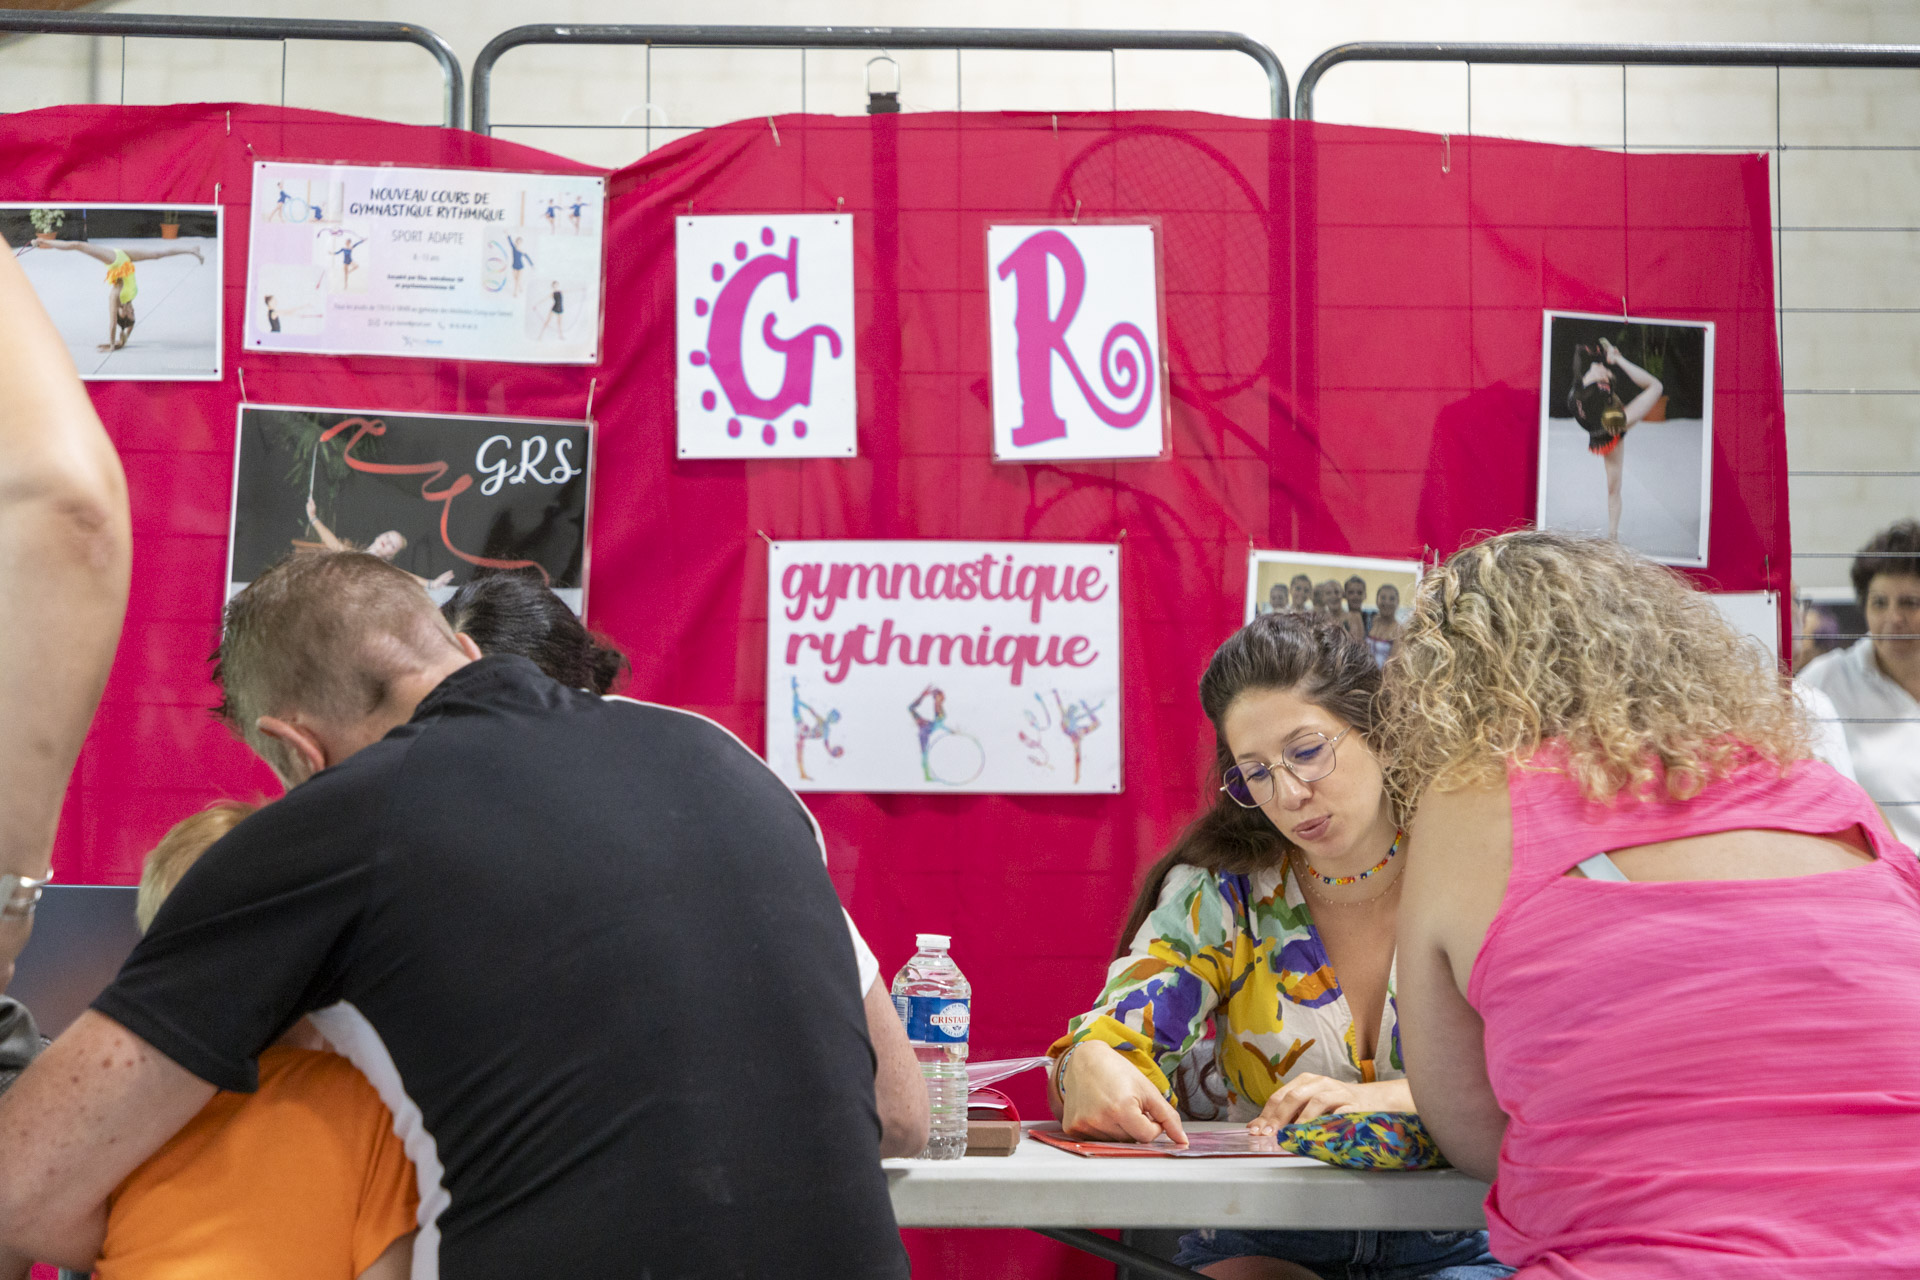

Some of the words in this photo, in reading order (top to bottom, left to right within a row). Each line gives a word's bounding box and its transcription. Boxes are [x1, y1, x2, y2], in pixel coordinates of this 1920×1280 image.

[349, 202, 433, 218] GYMNASTIQUE
[436, 205, 505, 222] RYTHMIQUE
[370, 187, 428, 202] NOUVEAU
[431, 190, 469, 205] COURS
[474, 192, 490, 204] DE
[391, 229, 422, 242] SPORT
[705, 226, 842, 447] G
[998, 229, 1155, 448] R
[475, 434, 582, 496] GRS
[781, 553, 1109, 624] gymnastique
[785, 619, 1099, 686] rythmique
